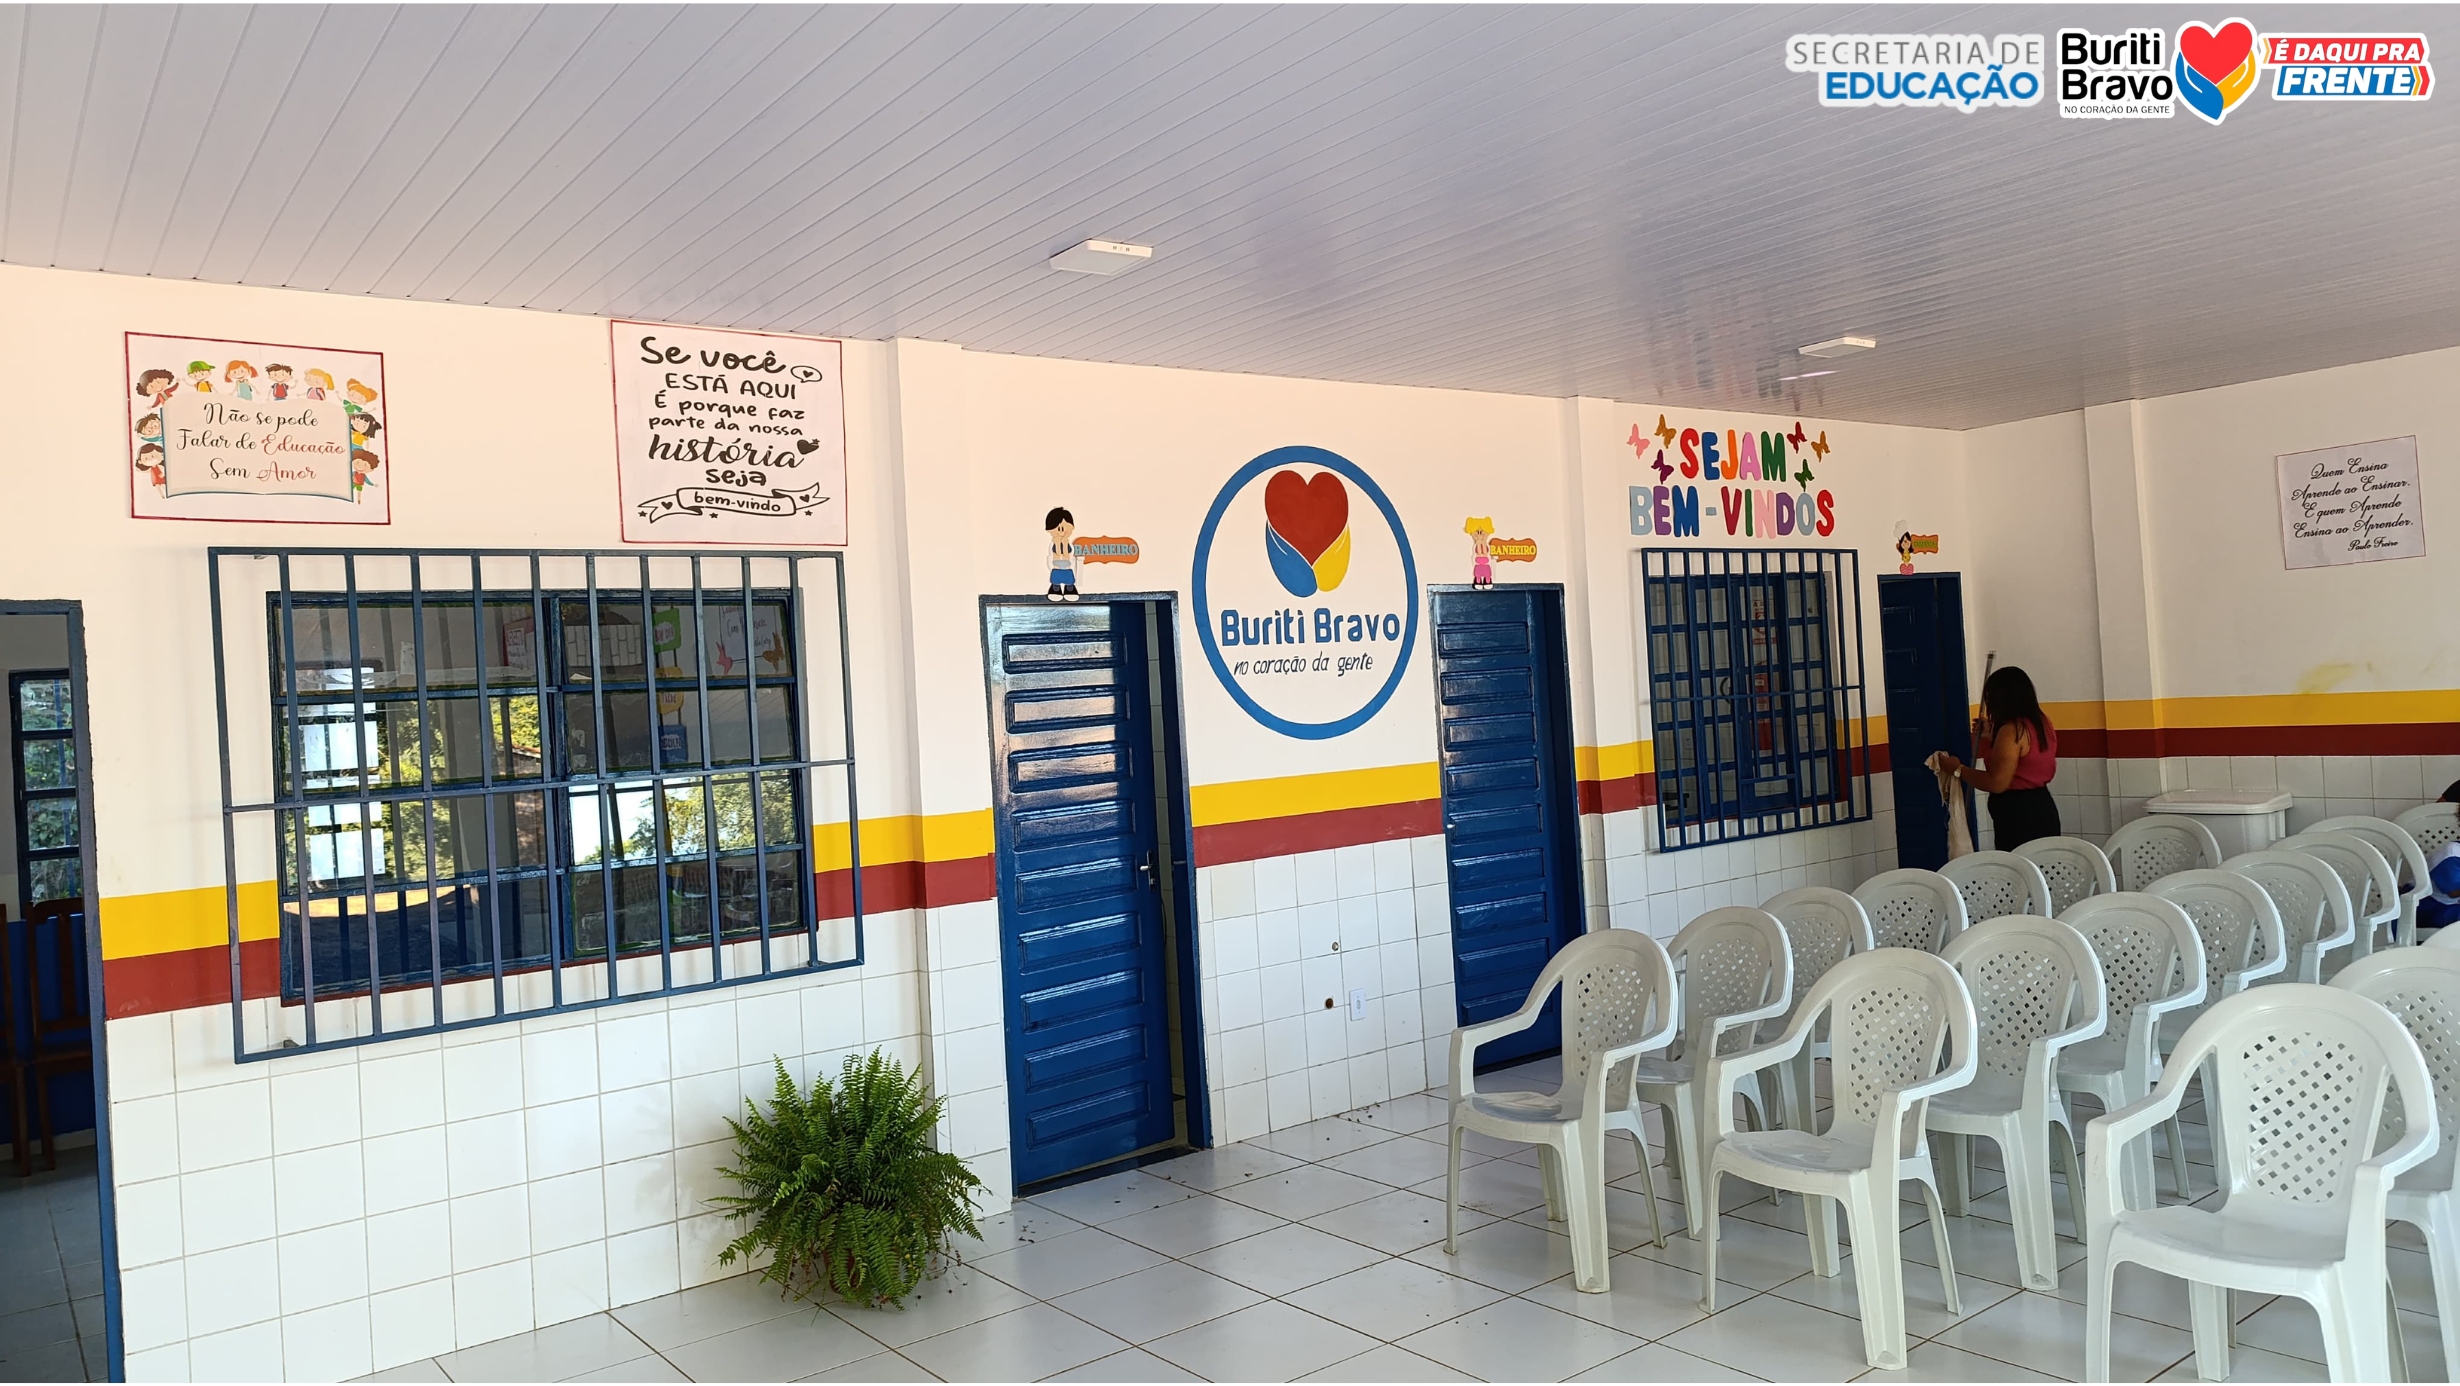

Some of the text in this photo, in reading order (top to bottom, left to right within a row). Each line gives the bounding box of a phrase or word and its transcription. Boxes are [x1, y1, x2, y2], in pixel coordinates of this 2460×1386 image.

[640, 336, 786, 374] Se você
[665, 372, 796, 400] ESTÁ AQUI
[203, 402, 319, 433] Não se pode
[654, 389, 805, 420] É porque faz
[648, 416, 803, 436] parte da nossa
[176, 428, 346, 456] Falar de Educação
[648, 433, 804, 468] história
[1680, 428, 1787, 482] SEJAM
[209, 457, 317, 483] Sem Amor
[705, 468, 767, 487] seja
[2310, 457, 2389, 480] Quem Ensina
[694, 490, 781, 513] bem-vindo
[2291, 481, 2342, 507] Aprende
[2344, 486, 2358, 495] ao
[2316, 507, 2346, 525] quem
[2349, 493, 2402, 519] Aprende
[2293, 522, 2333, 538] Ensina
[2335, 526, 2349, 534] ao
[1073, 543, 1139, 557] BANHEIRO
[1490, 544, 1536, 556] BANHEIRO
[2348, 539, 2372, 551] Paulo
[1220, 607, 1401, 647] Buriti Bravo
[1233, 651, 1373, 677] no coração da gente
